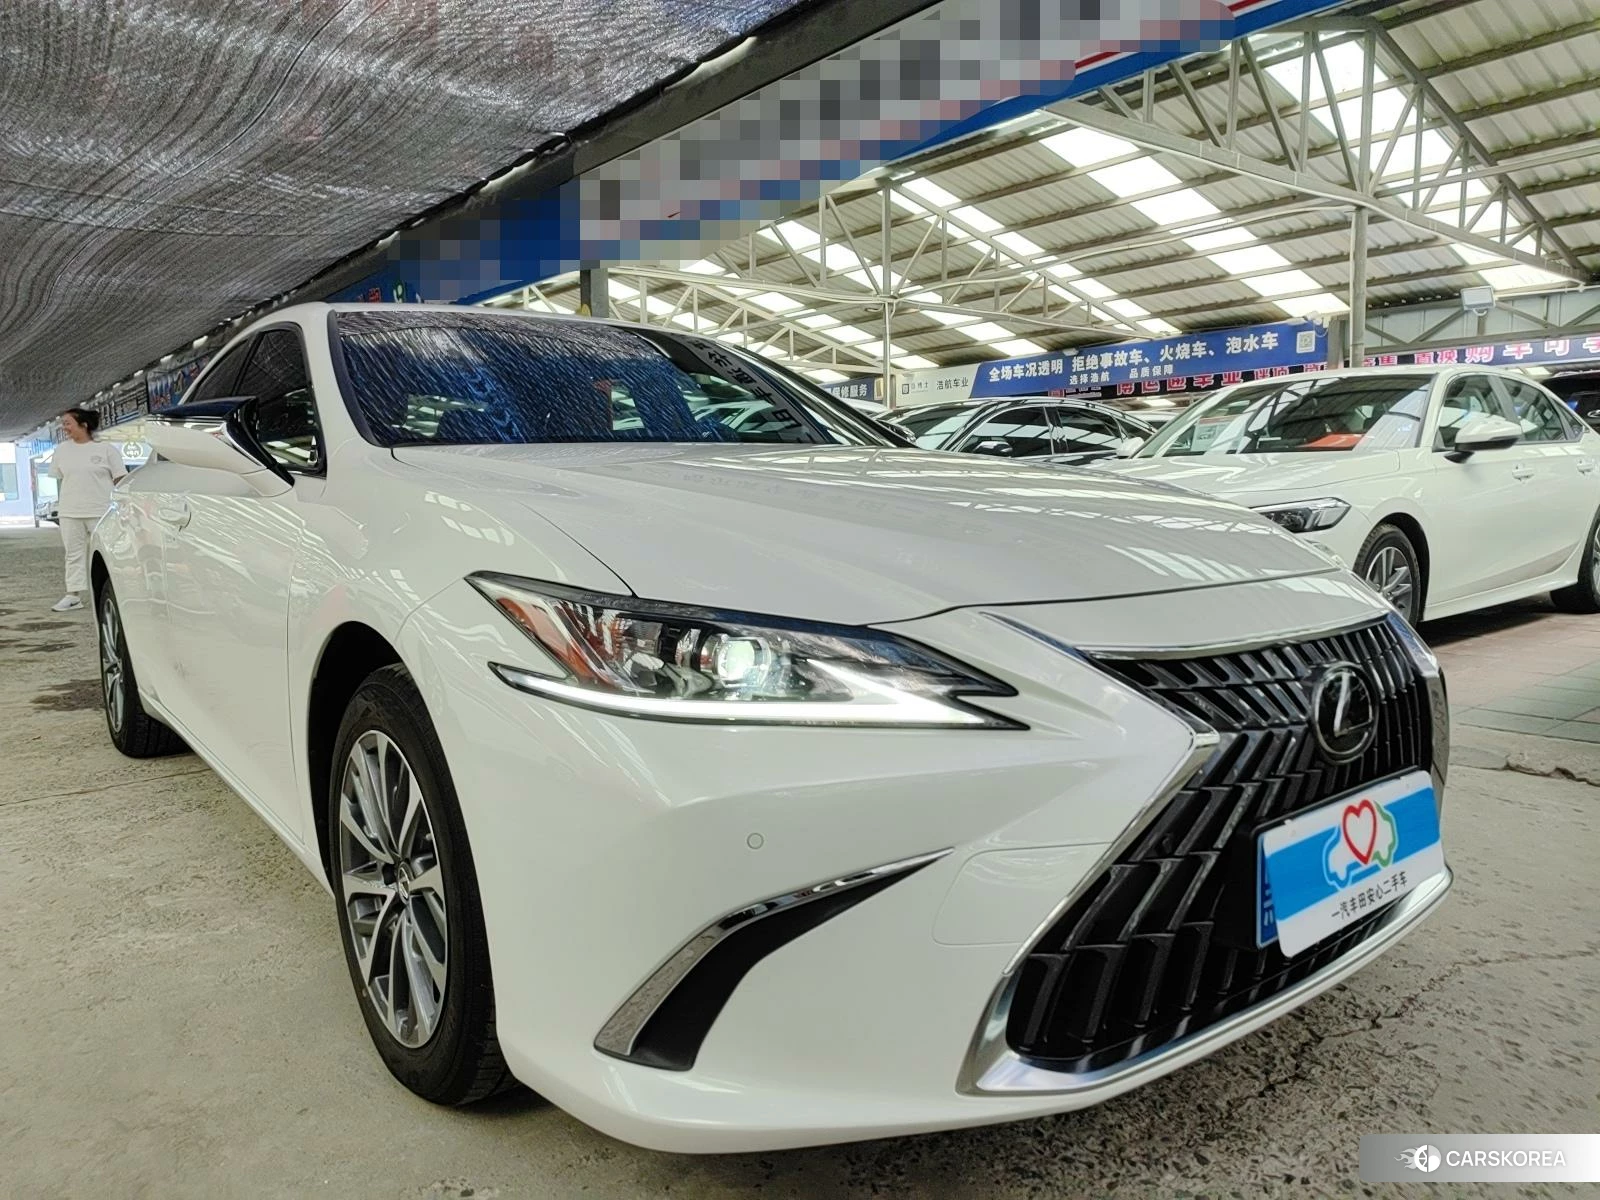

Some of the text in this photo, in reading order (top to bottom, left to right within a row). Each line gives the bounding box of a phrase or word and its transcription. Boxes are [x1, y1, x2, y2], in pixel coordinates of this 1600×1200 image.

[989, 358, 1063, 383] 全场车况透明
[1129, 364, 1174, 379] 品质保障
[936, 376, 969, 391] 浩航车业
